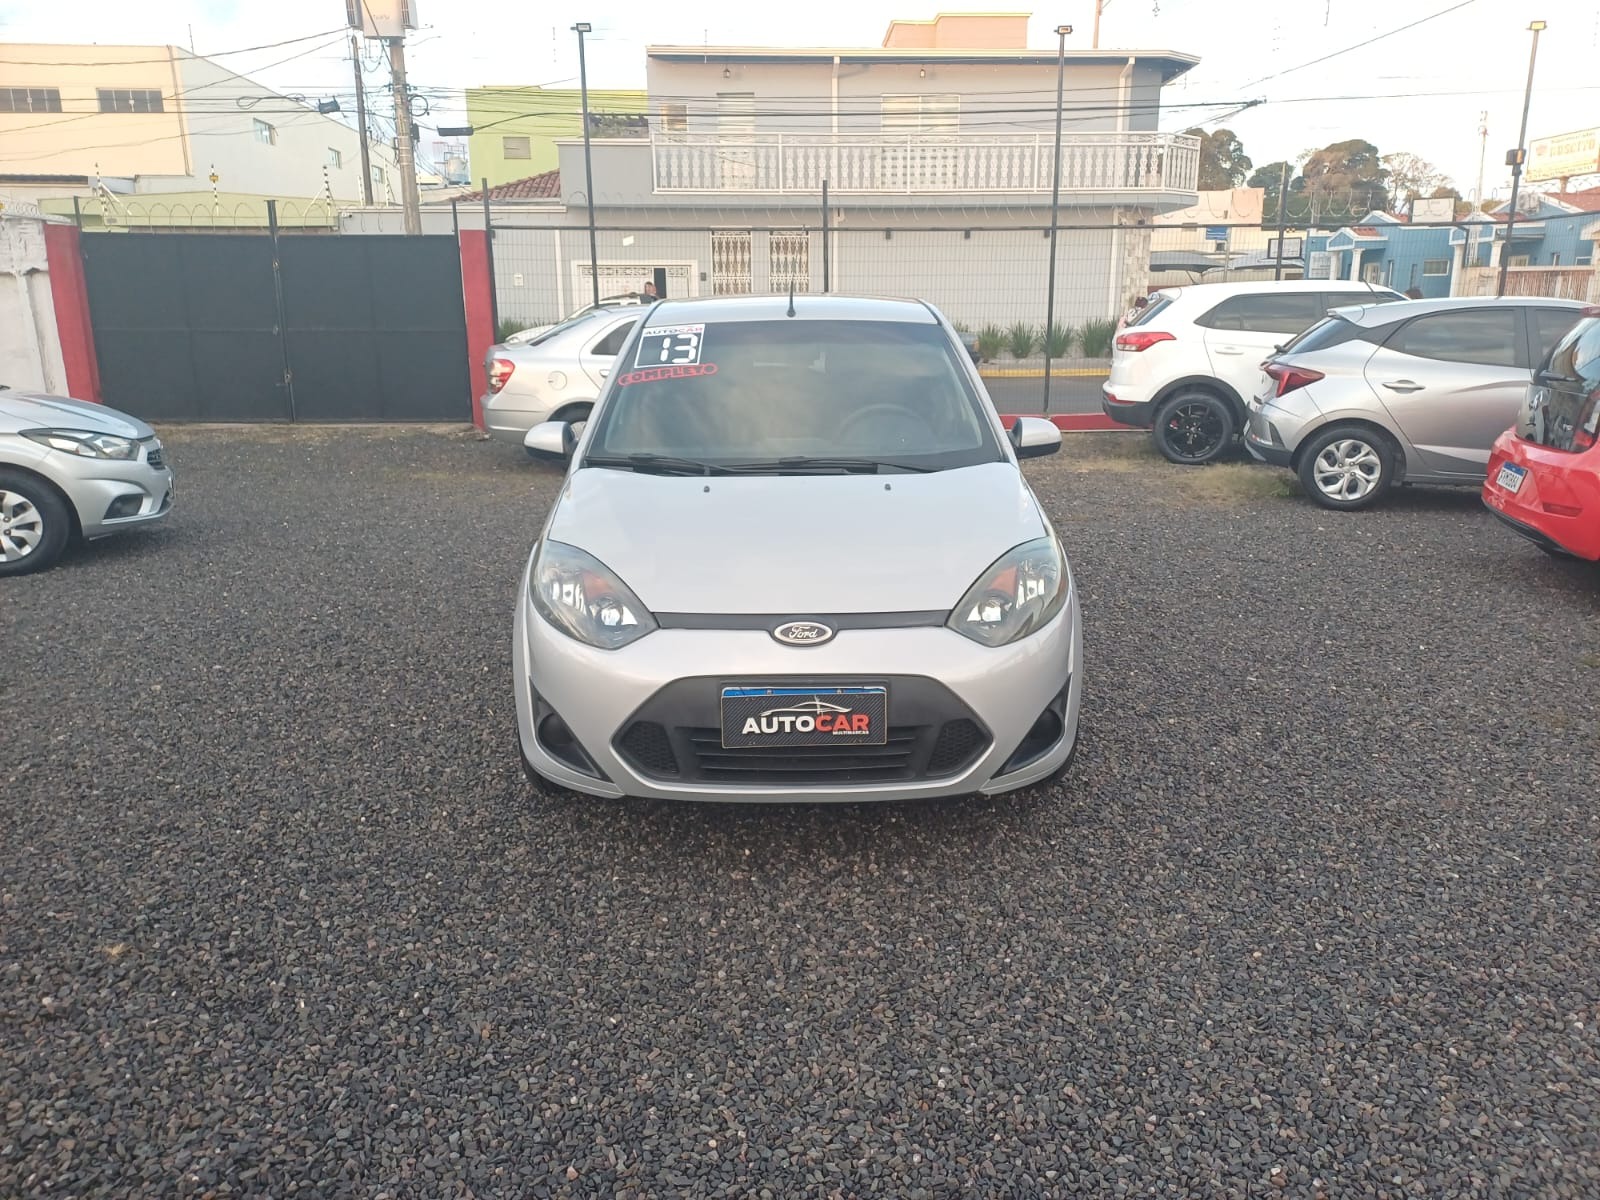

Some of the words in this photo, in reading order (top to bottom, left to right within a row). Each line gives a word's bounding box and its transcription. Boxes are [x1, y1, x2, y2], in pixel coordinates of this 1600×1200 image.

[644, 326, 703, 335] AUTOCAR
[660, 334, 698, 363] 13
[618, 363, 718, 386] COMPLETO
[788, 625, 818, 639] Ford
[742, 714, 870, 735] AUTOCAR
